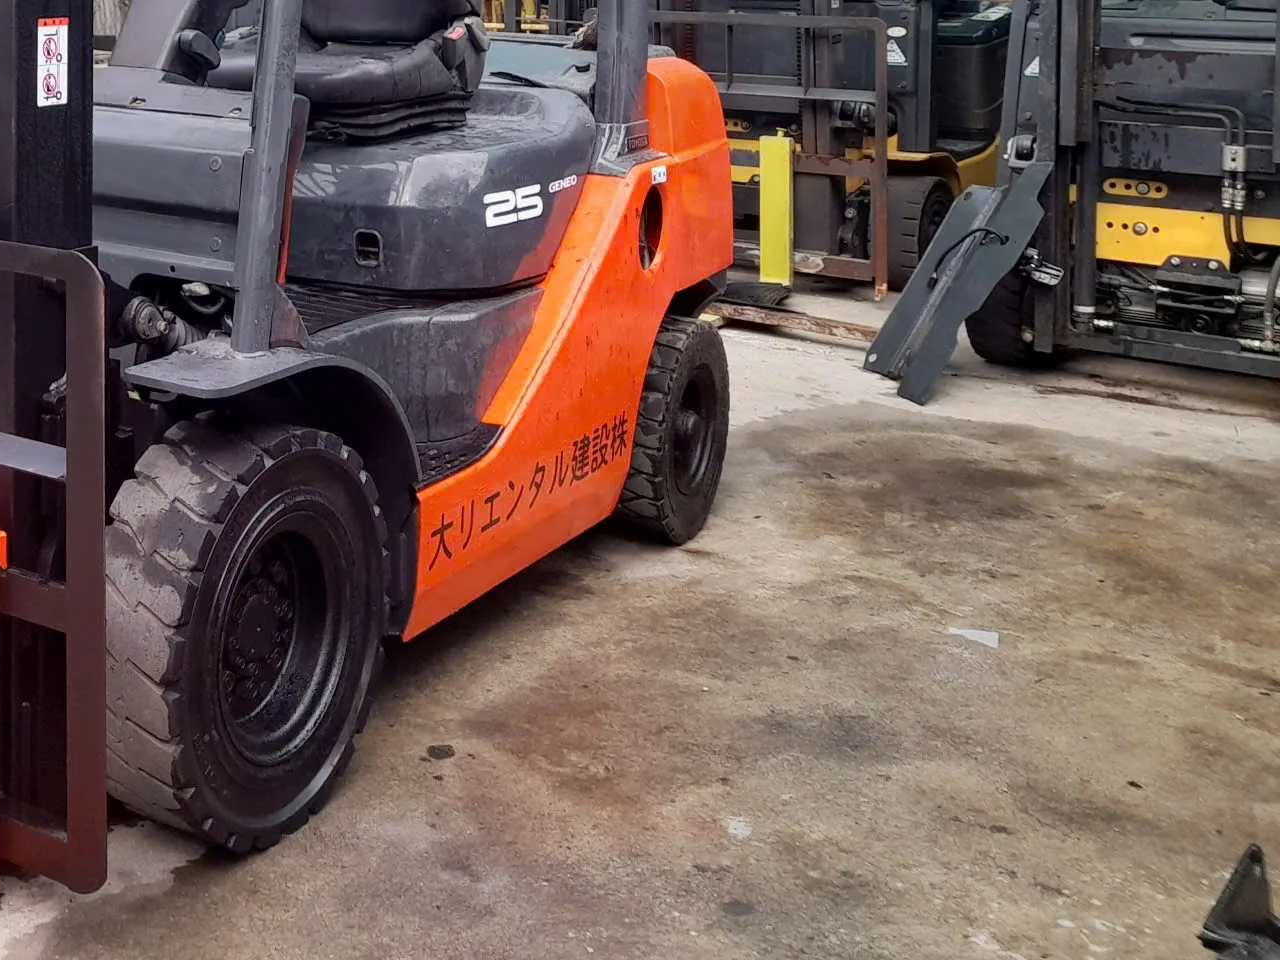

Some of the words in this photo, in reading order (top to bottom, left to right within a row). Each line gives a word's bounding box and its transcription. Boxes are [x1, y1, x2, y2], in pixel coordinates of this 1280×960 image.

[483, 184, 544, 228] 25
[548, 174, 578, 193] GENEO
[429, 411, 628, 571] 大リエンタル建設株
